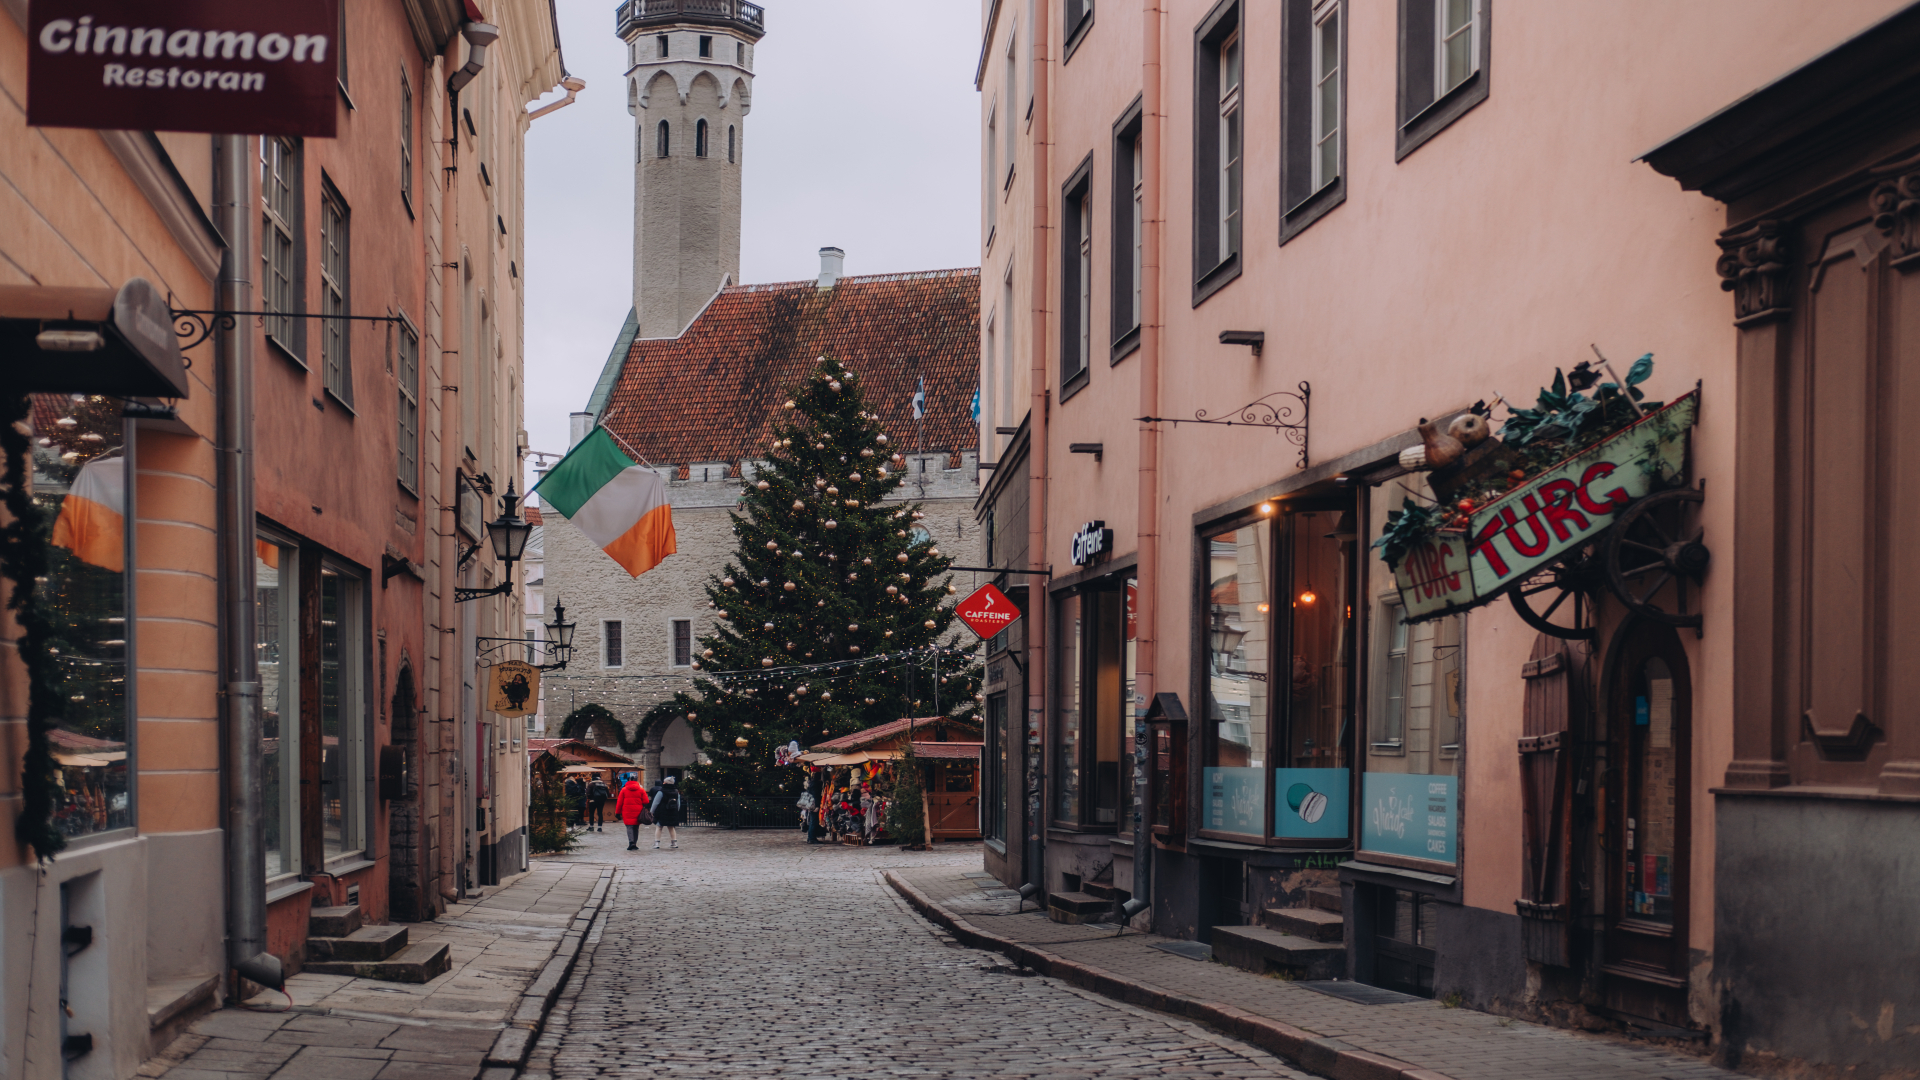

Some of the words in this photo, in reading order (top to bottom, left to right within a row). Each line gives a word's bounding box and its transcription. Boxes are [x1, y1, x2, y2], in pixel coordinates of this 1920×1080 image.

[39, 15, 328, 63] Cinnamon
[102, 63, 266, 92] Restoran
[1469, 461, 1630, 580] TURG
[1071, 520, 1103, 566] Caffeine
[1404, 540, 1462, 605] TURG
[965, 610, 1011, 620] CAFFEINE
[1428, 783, 1447, 795] COFFEE
[1427, 815, 1446, 827] SALADS
[1427, 839, 1446, 853] CAKES
